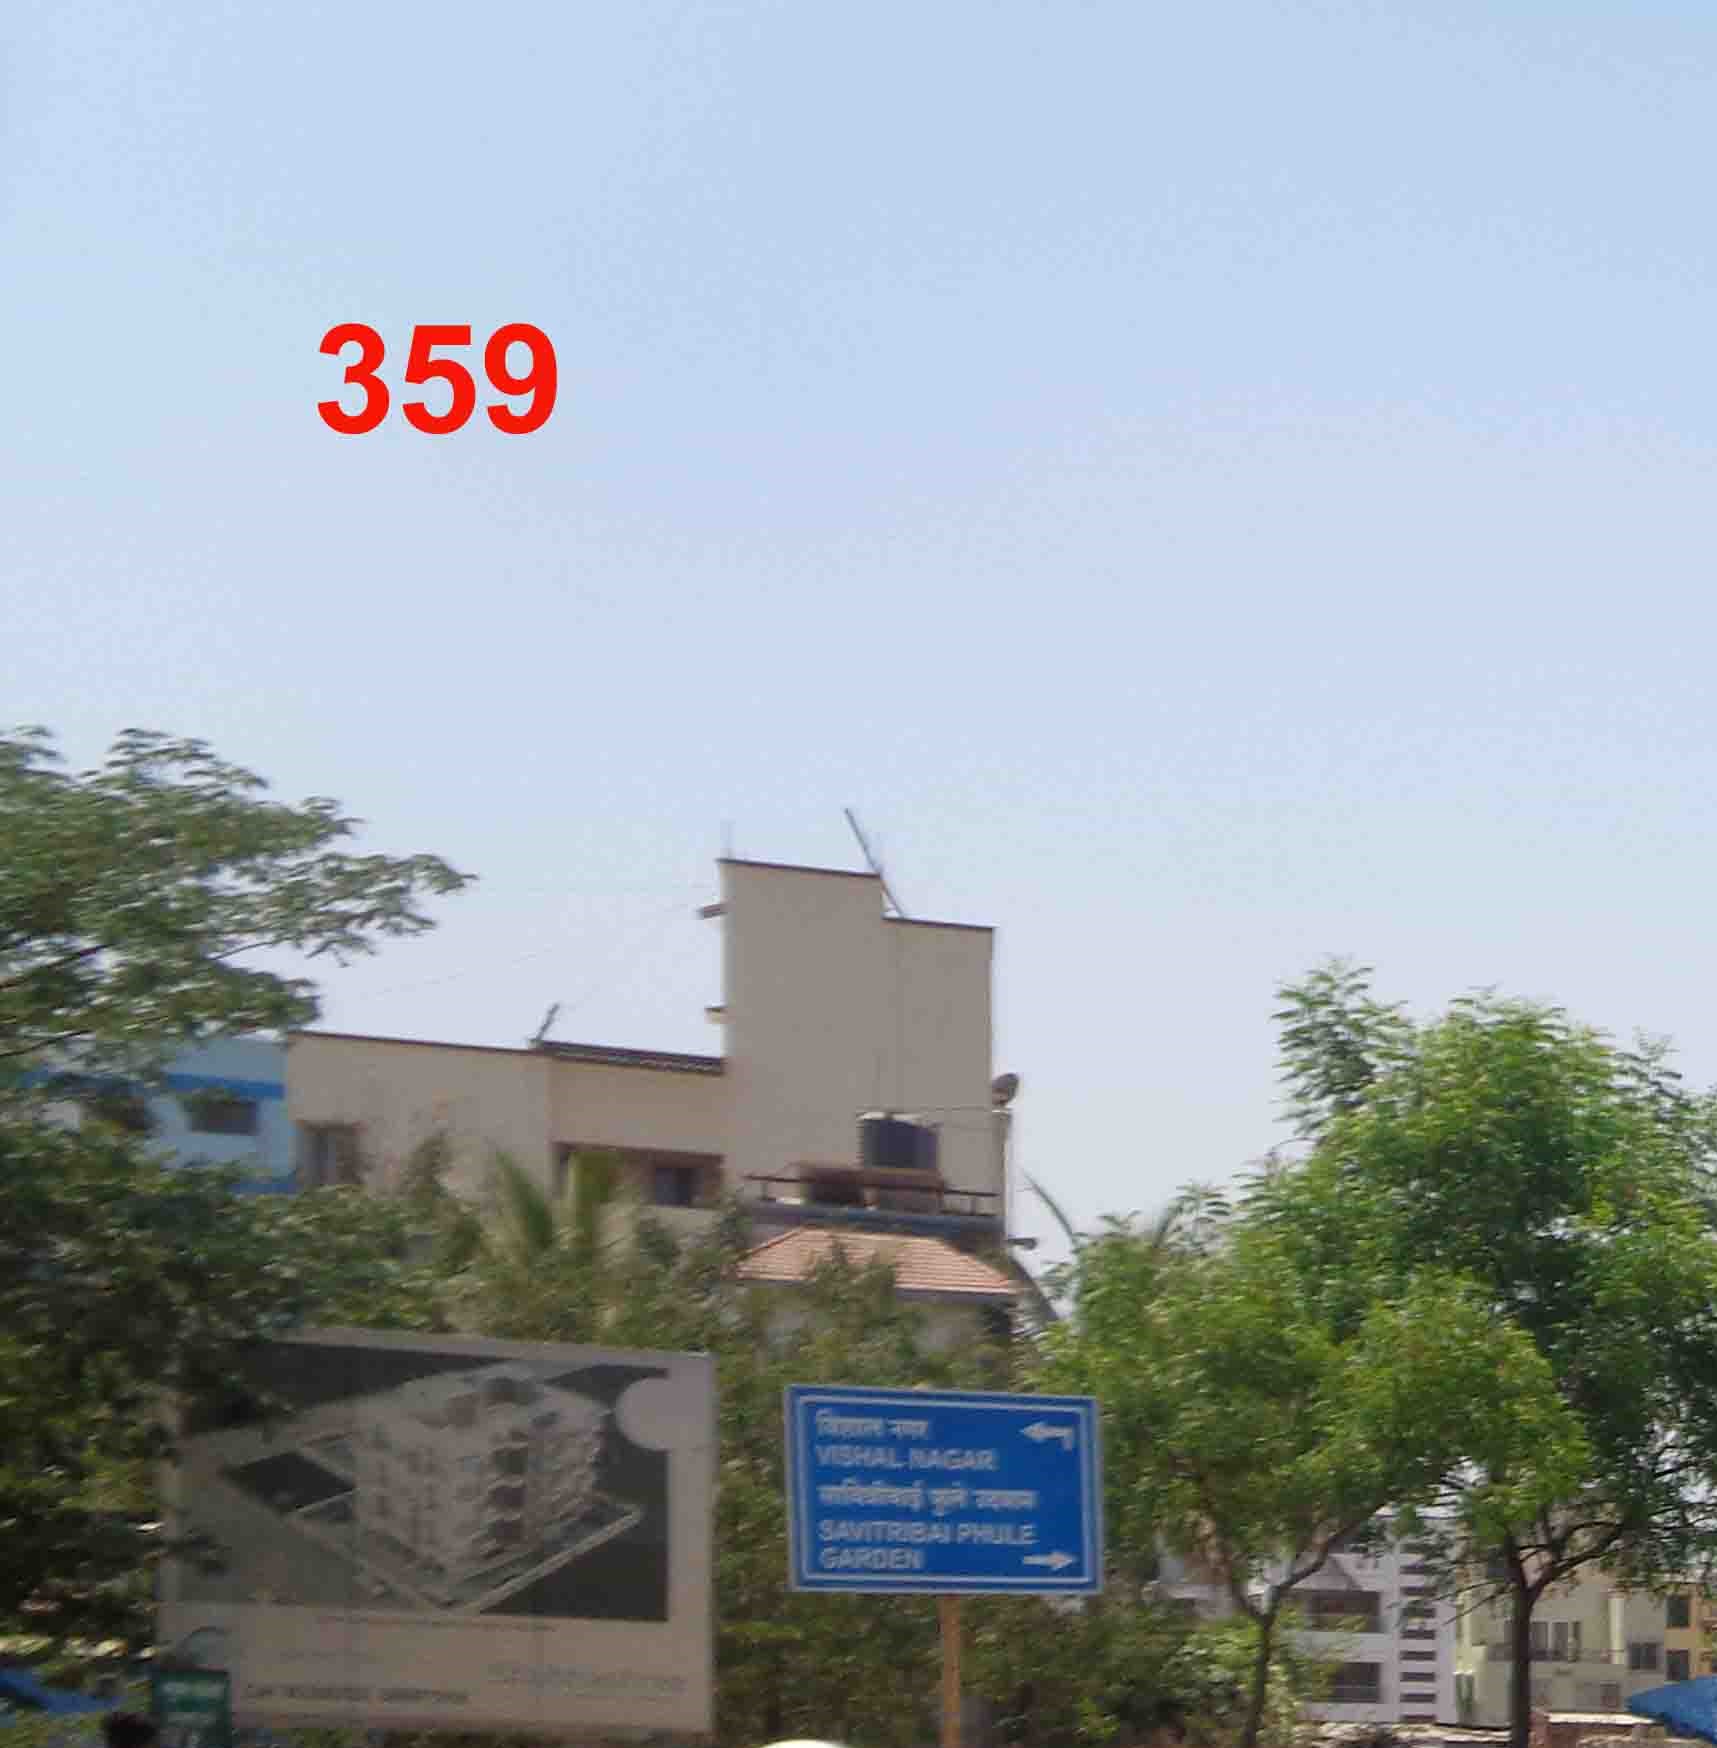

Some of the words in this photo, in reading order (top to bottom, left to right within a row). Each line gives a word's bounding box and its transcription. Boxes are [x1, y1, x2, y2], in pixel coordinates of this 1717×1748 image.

[815, 1444, 902, 1469] VISHAL
[909, 1448, 998, 1470] NAGAR
[818, 1519, 950, 1543] SAVITRIBAI
[956, 1522, 1038, 1545] PHULE
[822, 1546, 921, 1569] GARDEN
